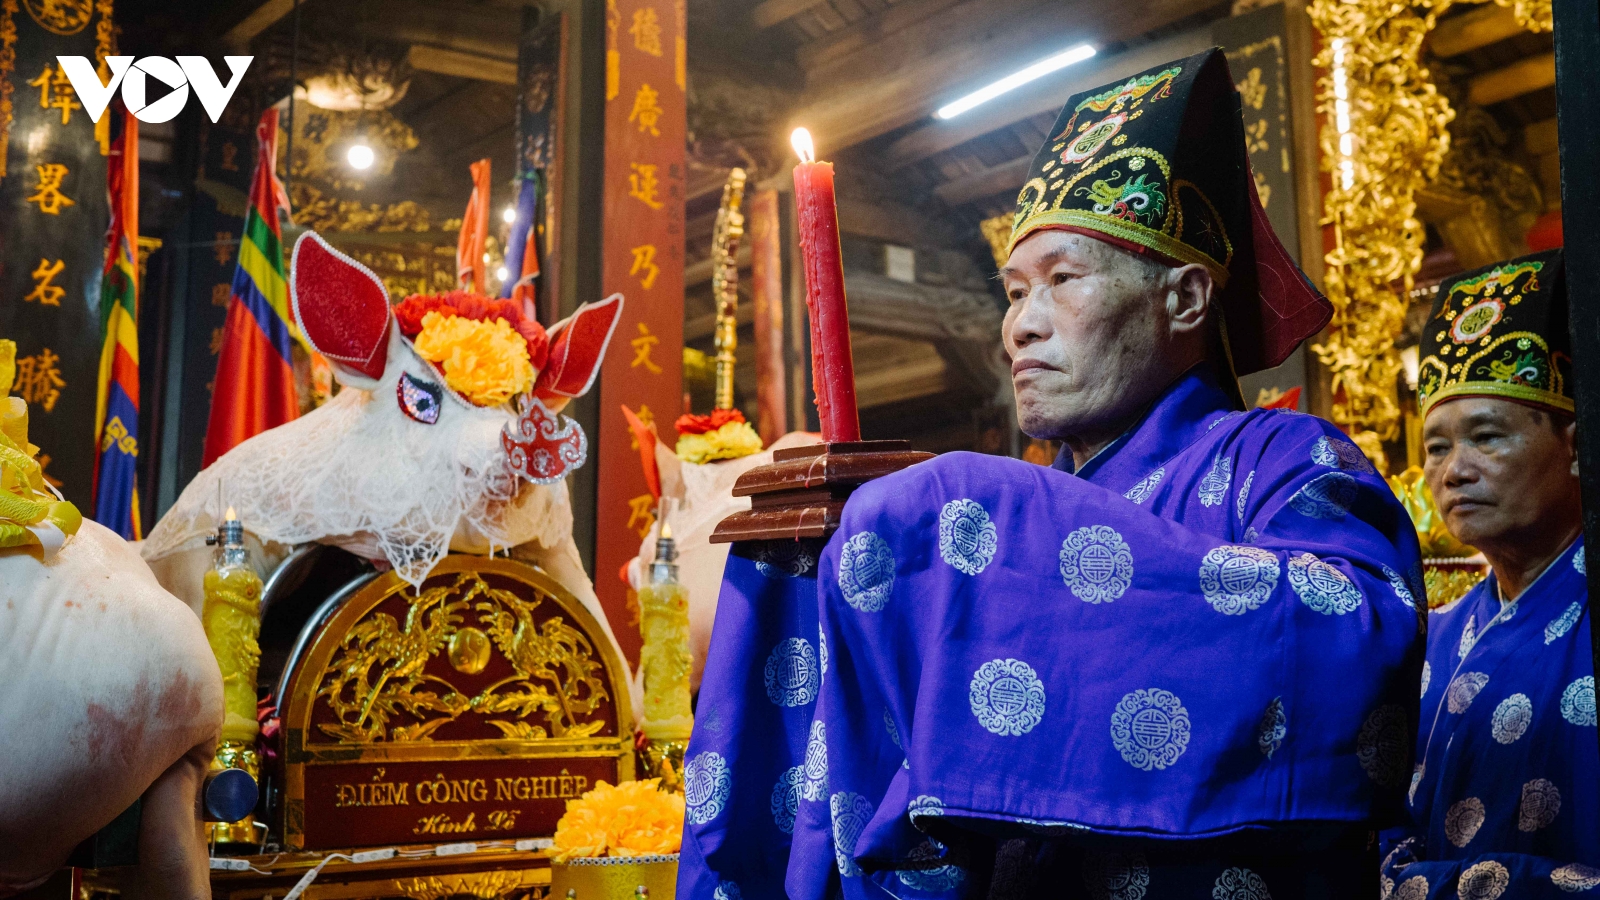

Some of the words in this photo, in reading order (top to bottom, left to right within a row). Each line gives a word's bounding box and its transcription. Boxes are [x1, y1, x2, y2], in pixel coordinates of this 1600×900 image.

[336, 767, 409, 807] ĐIỂM
[416, 773, 488, 804] CÔNG
[412, 812, 476, 835] Kính
[484, 810, 521, 830] Lễ
